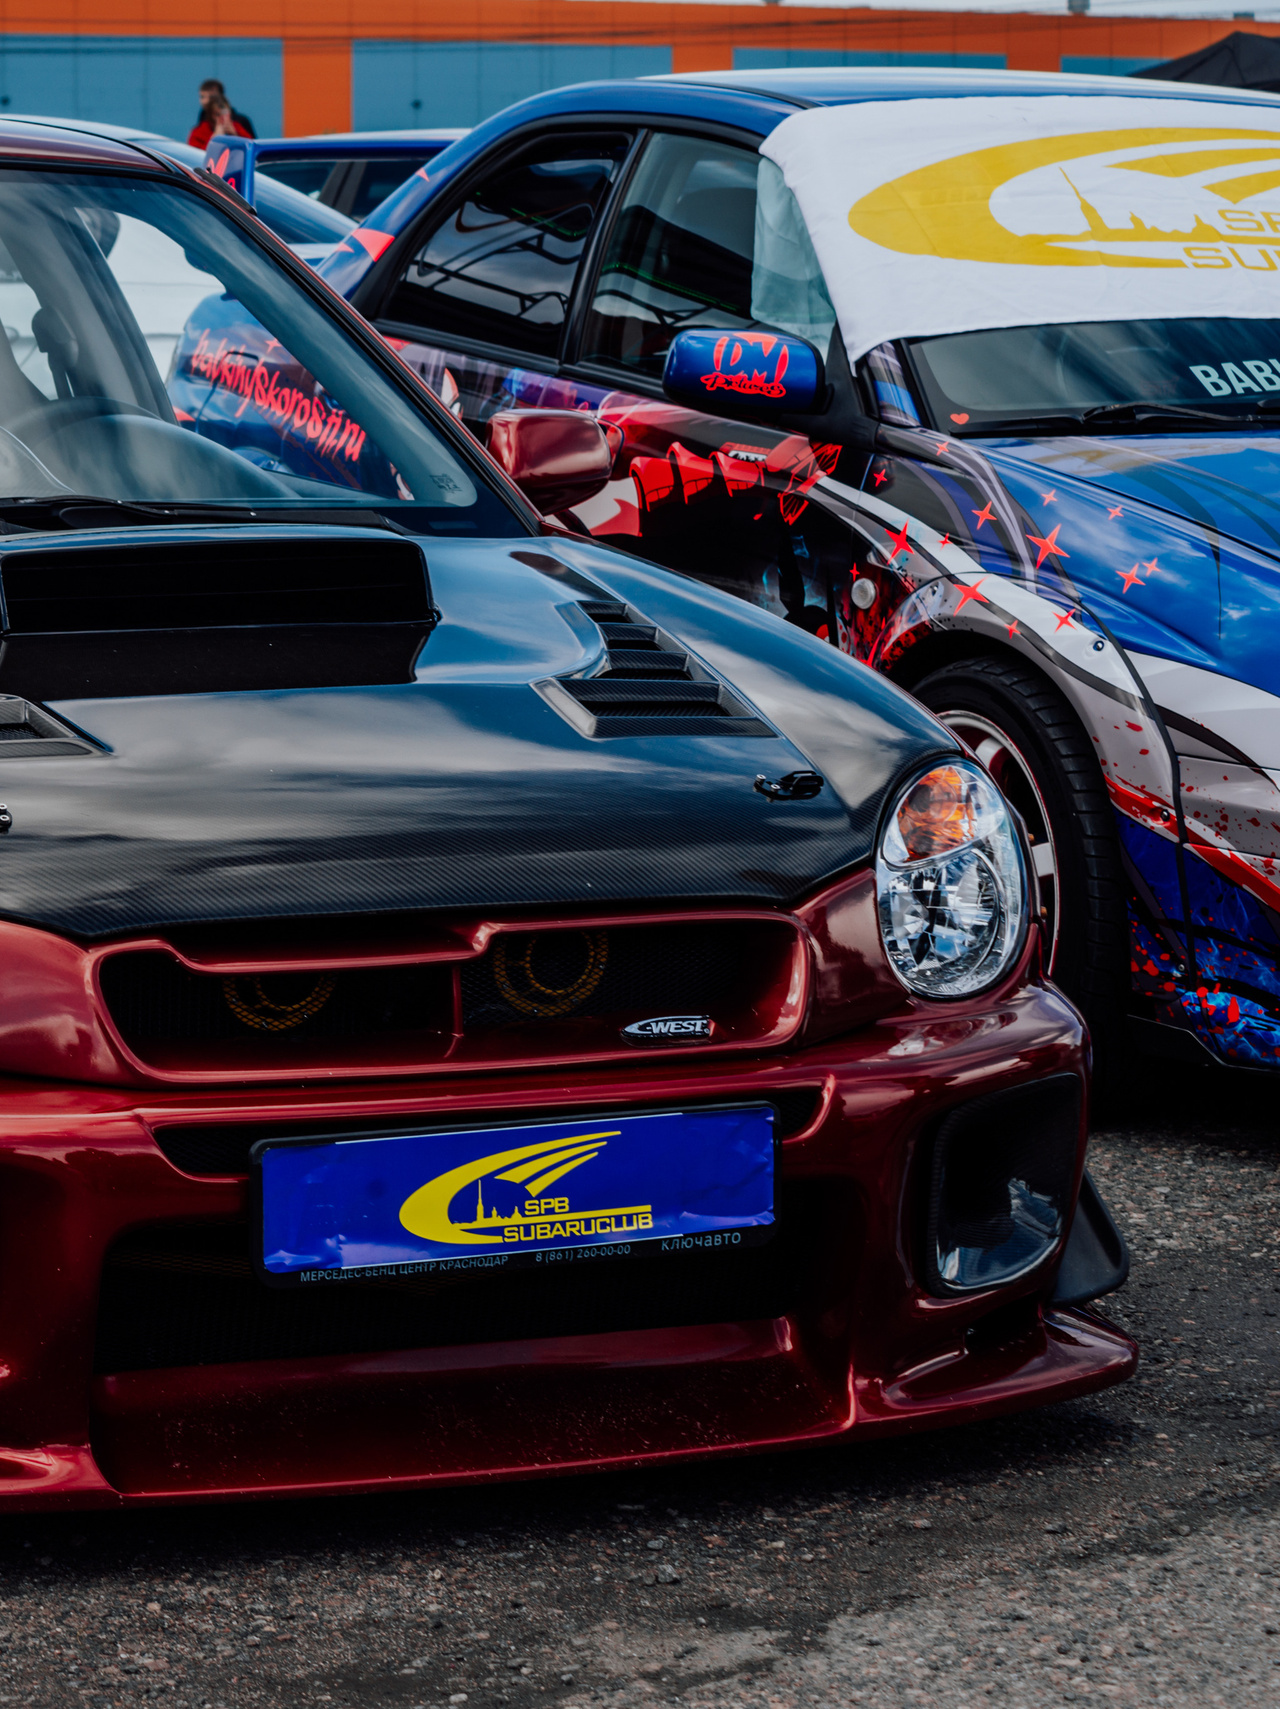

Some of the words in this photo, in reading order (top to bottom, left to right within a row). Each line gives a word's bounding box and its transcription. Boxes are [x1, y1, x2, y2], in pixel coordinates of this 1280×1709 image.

[1183, 245, 1280, 271] SU
[524, 1196, 570, 1216] SPB
[503, 1213, 654, 1243] SUBARUCLUB
[535, 1252, 543, 1263] 8
[545, 1248, 574, 1264] (861)
[576, 1244, 632, 1260] 260-00-00
[300, 1266, 397, 1283] МЕРСЕДЕС-БЕНЦ
[399, 1261, 437, 1276] ЦЕНТР
[439, 1255, 509, 1271] КРАСНОДАР
